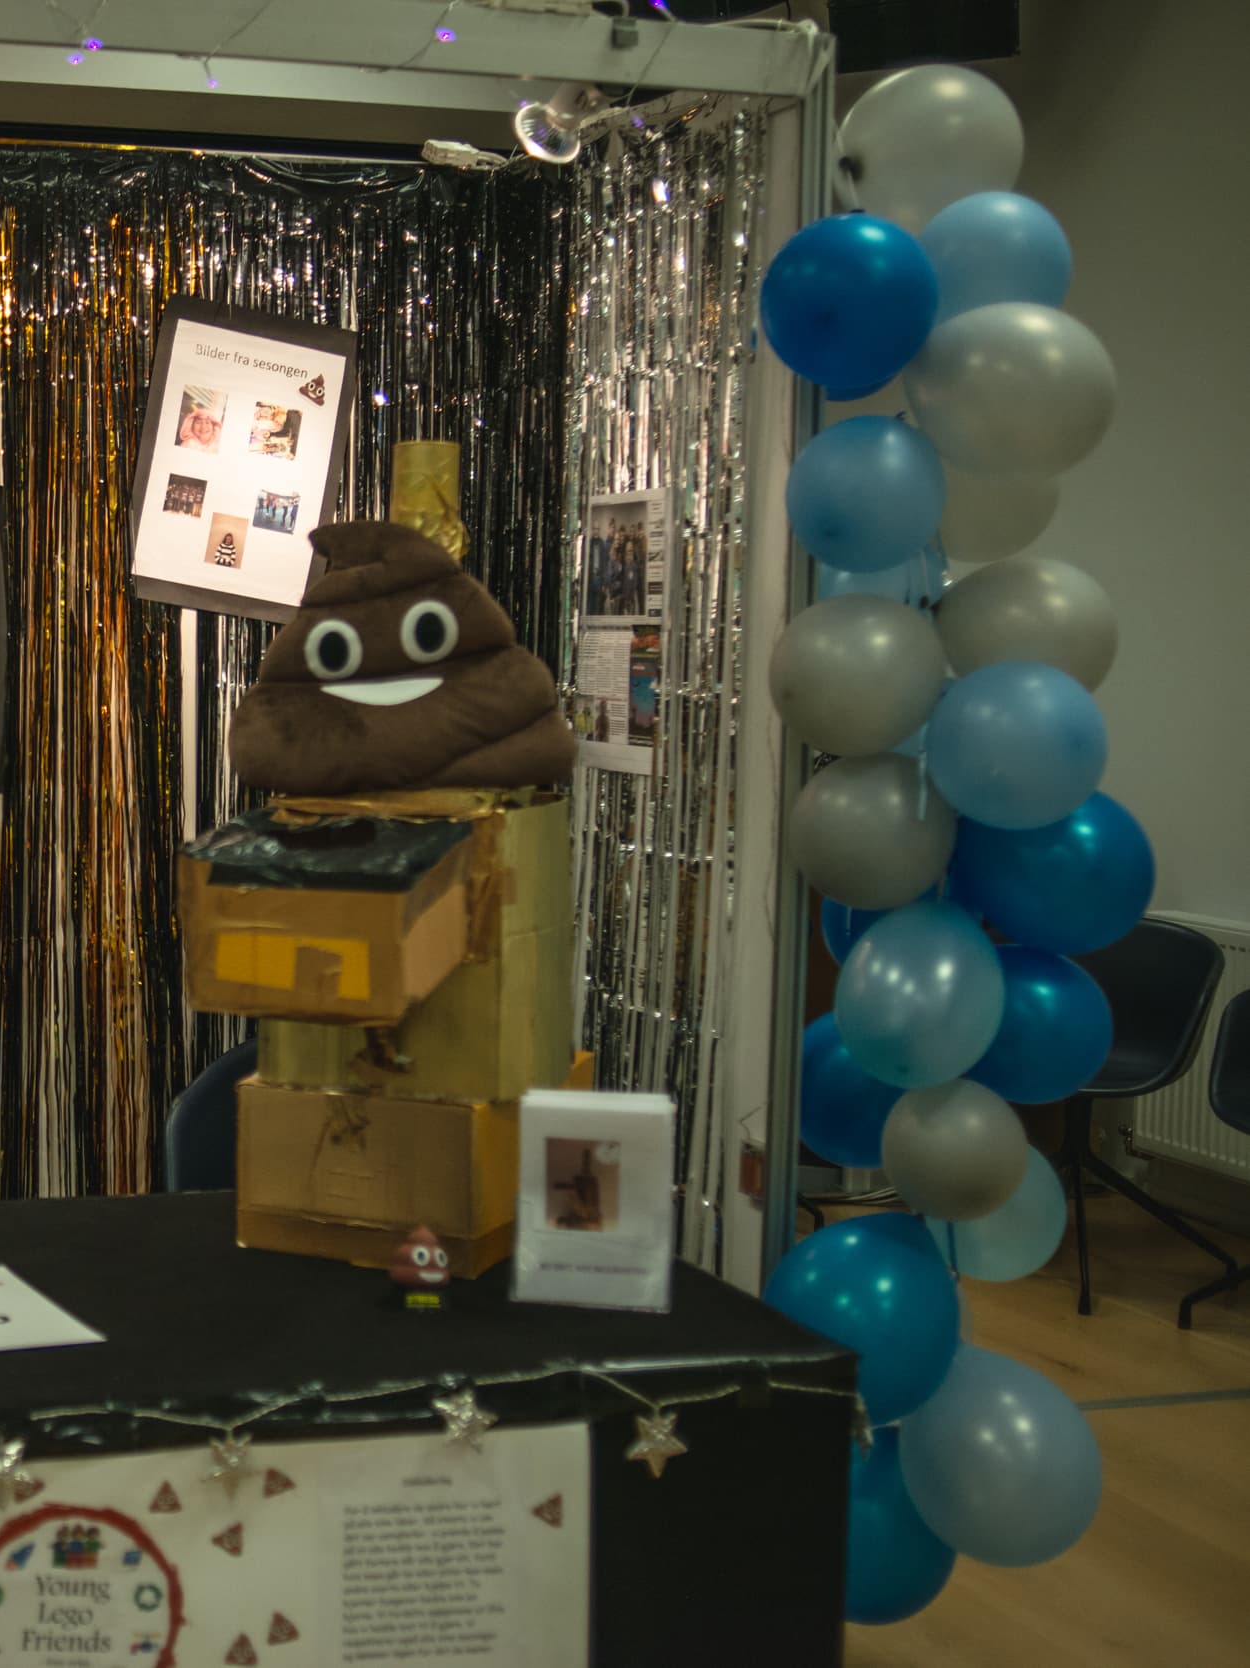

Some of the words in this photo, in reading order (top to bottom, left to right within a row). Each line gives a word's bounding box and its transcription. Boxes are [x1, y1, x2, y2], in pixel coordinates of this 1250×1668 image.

[195, 343, 230, 361] Bilder
[233, 351, 250, 366] fra
[253, 358, 308, 379] sesongen
[35, 1574, 111, 1604] Young
[37, 1603, 94, 1630] Lego
[21, 1629, 112, 1653] Friends
